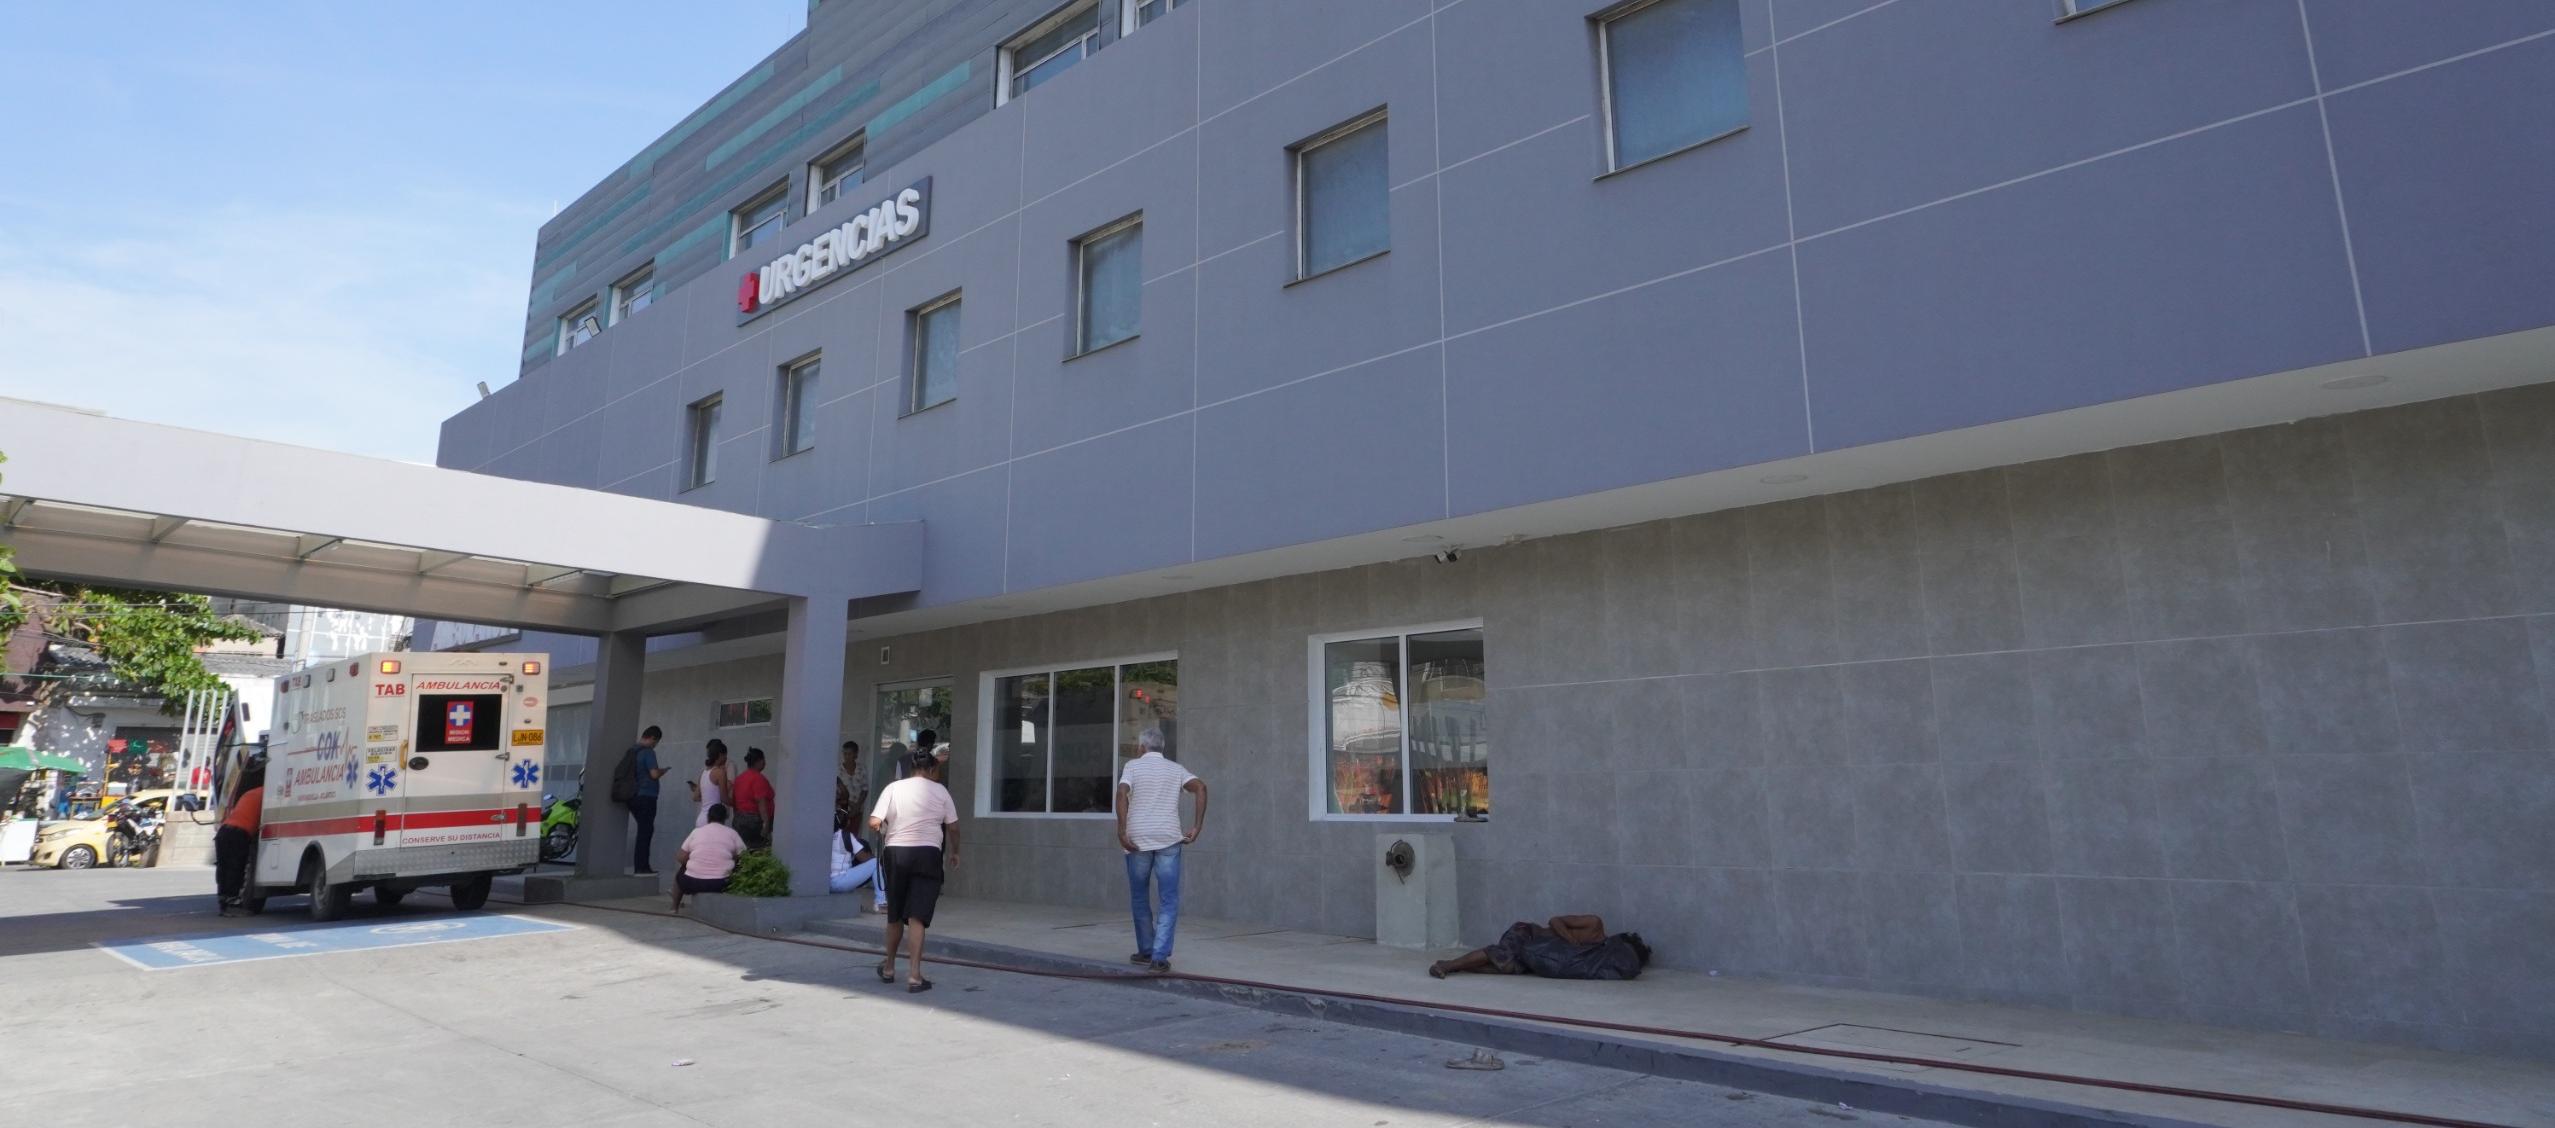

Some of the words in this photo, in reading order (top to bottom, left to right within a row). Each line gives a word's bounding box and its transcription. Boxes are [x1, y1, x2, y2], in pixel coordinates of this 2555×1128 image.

[758, 188, 920, 305] URGENCIAS
[375, 683, 405, 696] TAB
[416, 680, 500, 690] AMBULANCIA
[294, 763, 345, 786] AMBULANCIA
[402, 835, 446, 845] CONSERVE
[460, 832, 500, 841] DISTANCIA
